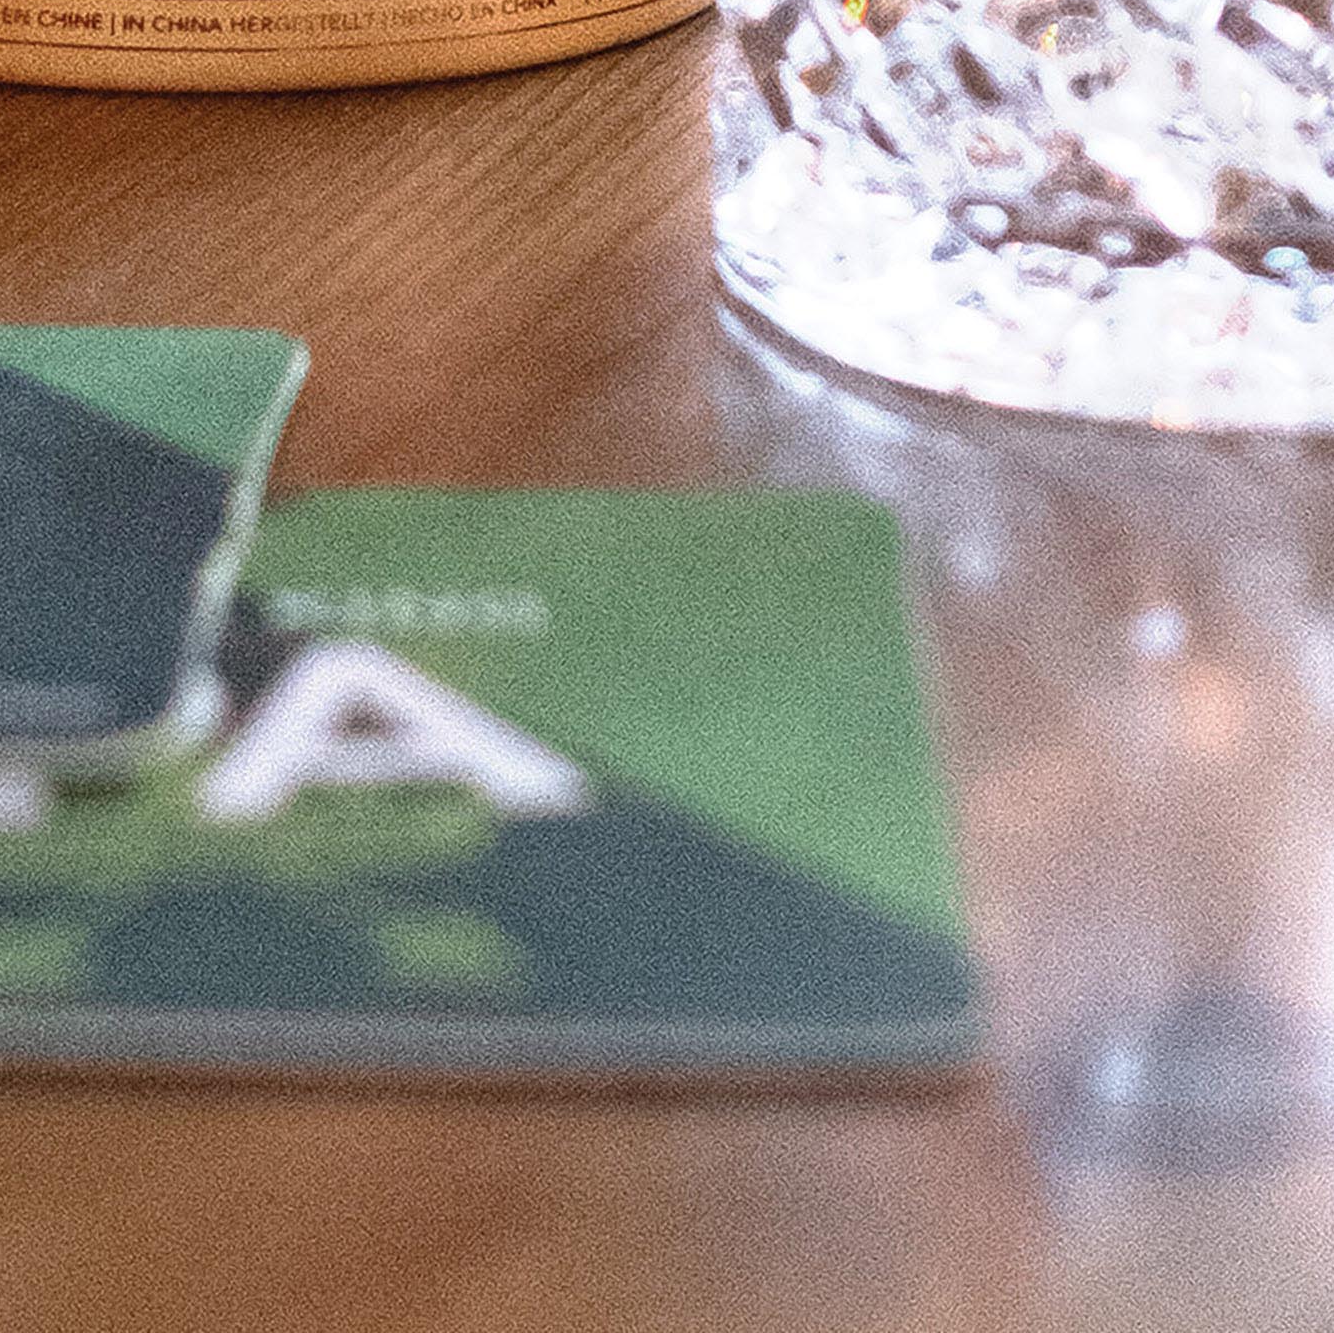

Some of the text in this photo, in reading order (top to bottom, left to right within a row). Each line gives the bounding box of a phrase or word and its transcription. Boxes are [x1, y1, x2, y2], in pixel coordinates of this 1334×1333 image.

[37, 11, 103, 32] CHINE
[121, 15, 147, 33] IN
[151, 14, 222, 34] CHINA
